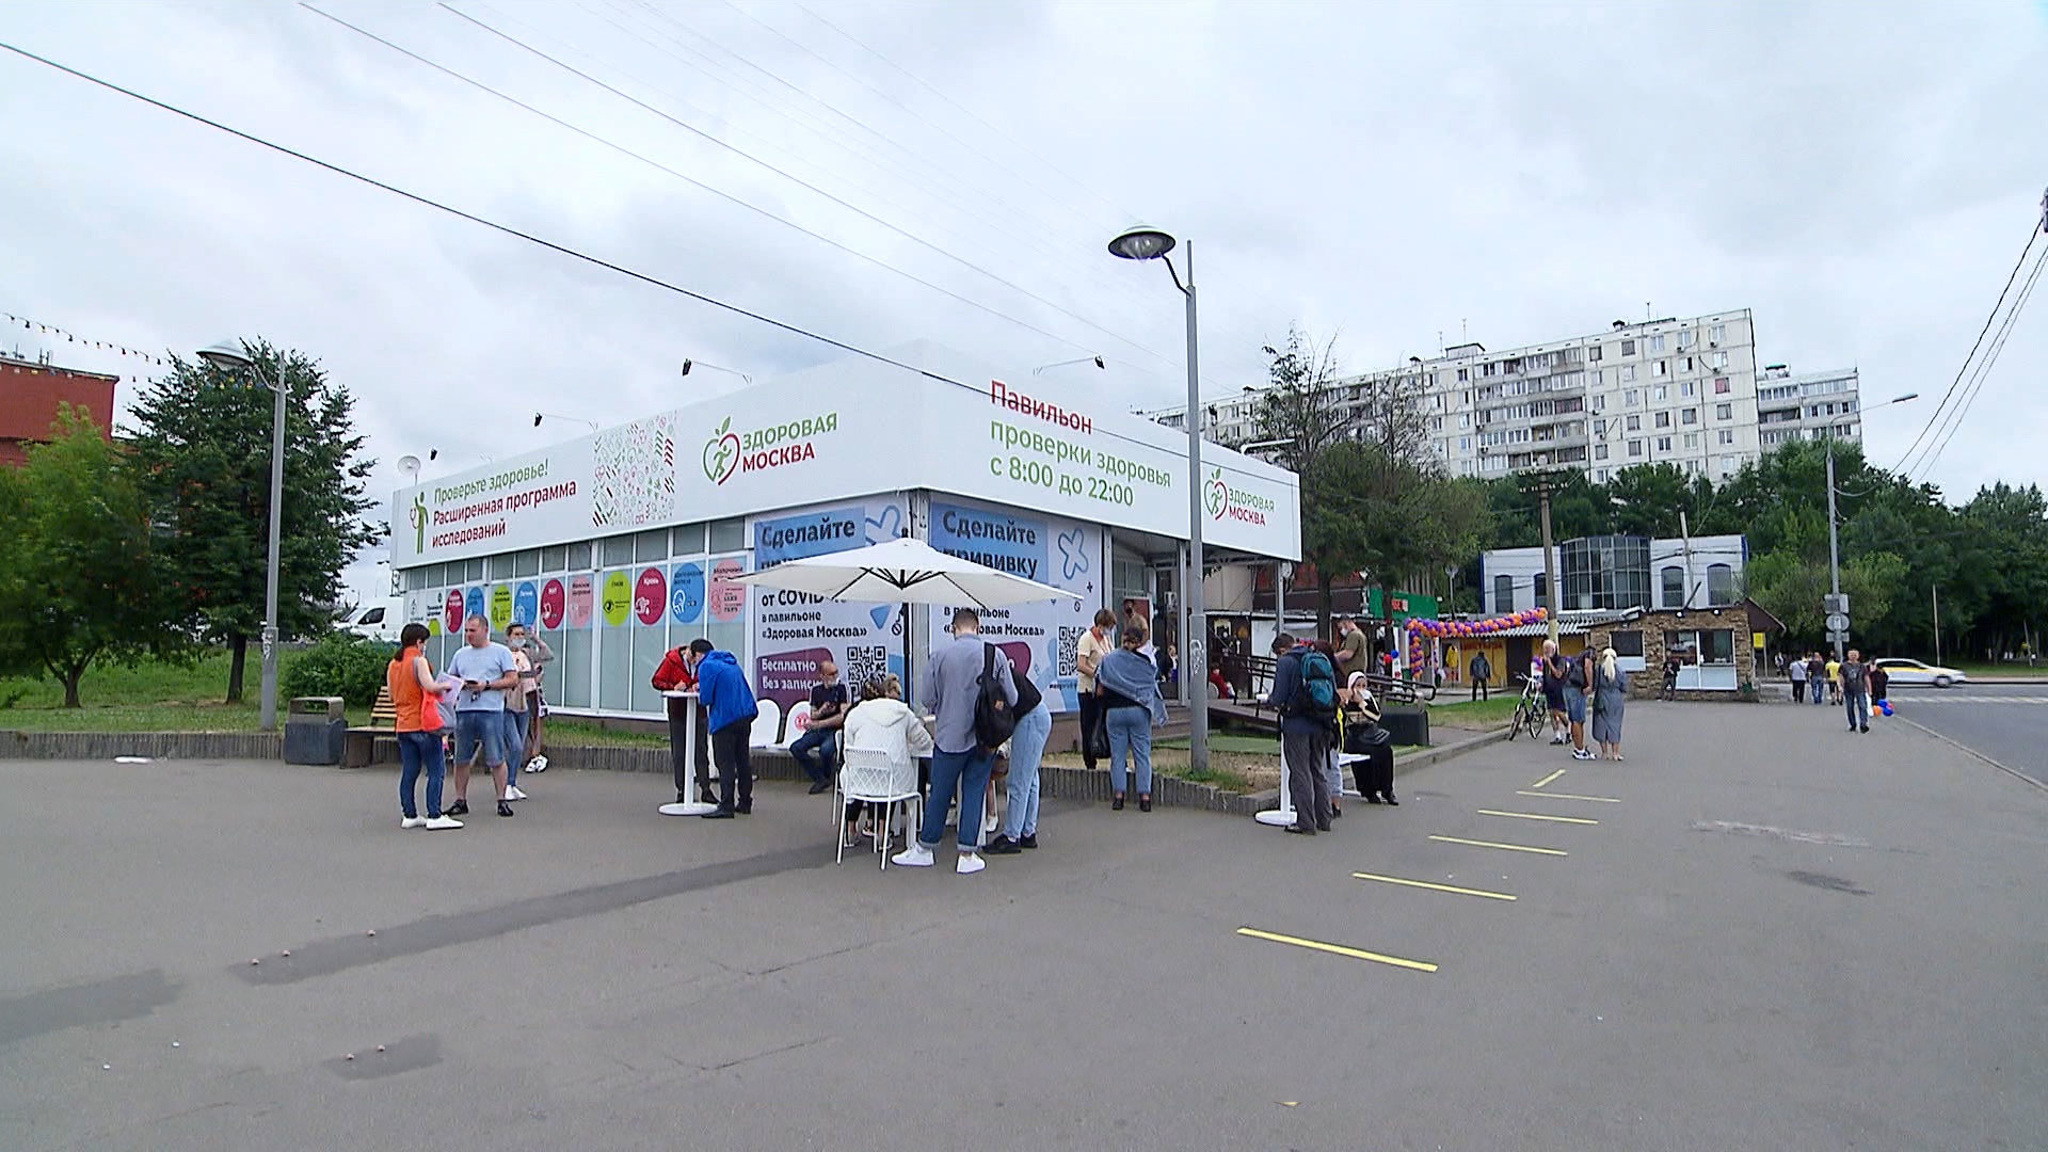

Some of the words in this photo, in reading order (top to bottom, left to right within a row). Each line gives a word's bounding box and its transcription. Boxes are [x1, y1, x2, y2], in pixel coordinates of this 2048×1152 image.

[991, 380, 1092, 435] Павильон
[742, 412, 837, 451] ЗДОРОВАЯ
[742, 442, 815, 473] МОСКВА
[990, 420, 1091, 466] проверки
[1097, 452, 1171, 488] здоровья
[434, 477, 487, 506] Проверьте
[489, 458, 548, 491] здоровье!
[990, 456, 1002, 476] с
[1009, 456, 1053, 487] 8:00
[1058, 474, 1083, 496] до
[1087, 477, 1134, 507] 22:00
[433, 498, 505, 527] Расширенная
[506, 480, 577, 512] программа
[1228, 488, 1275, 513] ЗДОРОВАЯ
[1229, 505, 1266, 527] МОСКВА
[432, 517, 506, 548] исследований
[761, 516, 856, 549] Сделайте
[942, 510, 1036, 545] Сделайте
[761, 594, 775, 607] от
[778, 589, 847, 606] COVID
[944, 606, 951, 616] в
[953, 606, 1010, 619] пильоне
[762, 627, 814, 641] «Здоровая
[816, 625, 867, 639] Москва»
[768, 611, 822, 624] павильоне
[943, 624, 1003, 636] «овая
[1004, 623, 1045, 636] Москва»
[761, 658, 817, 672] Бесплатно
